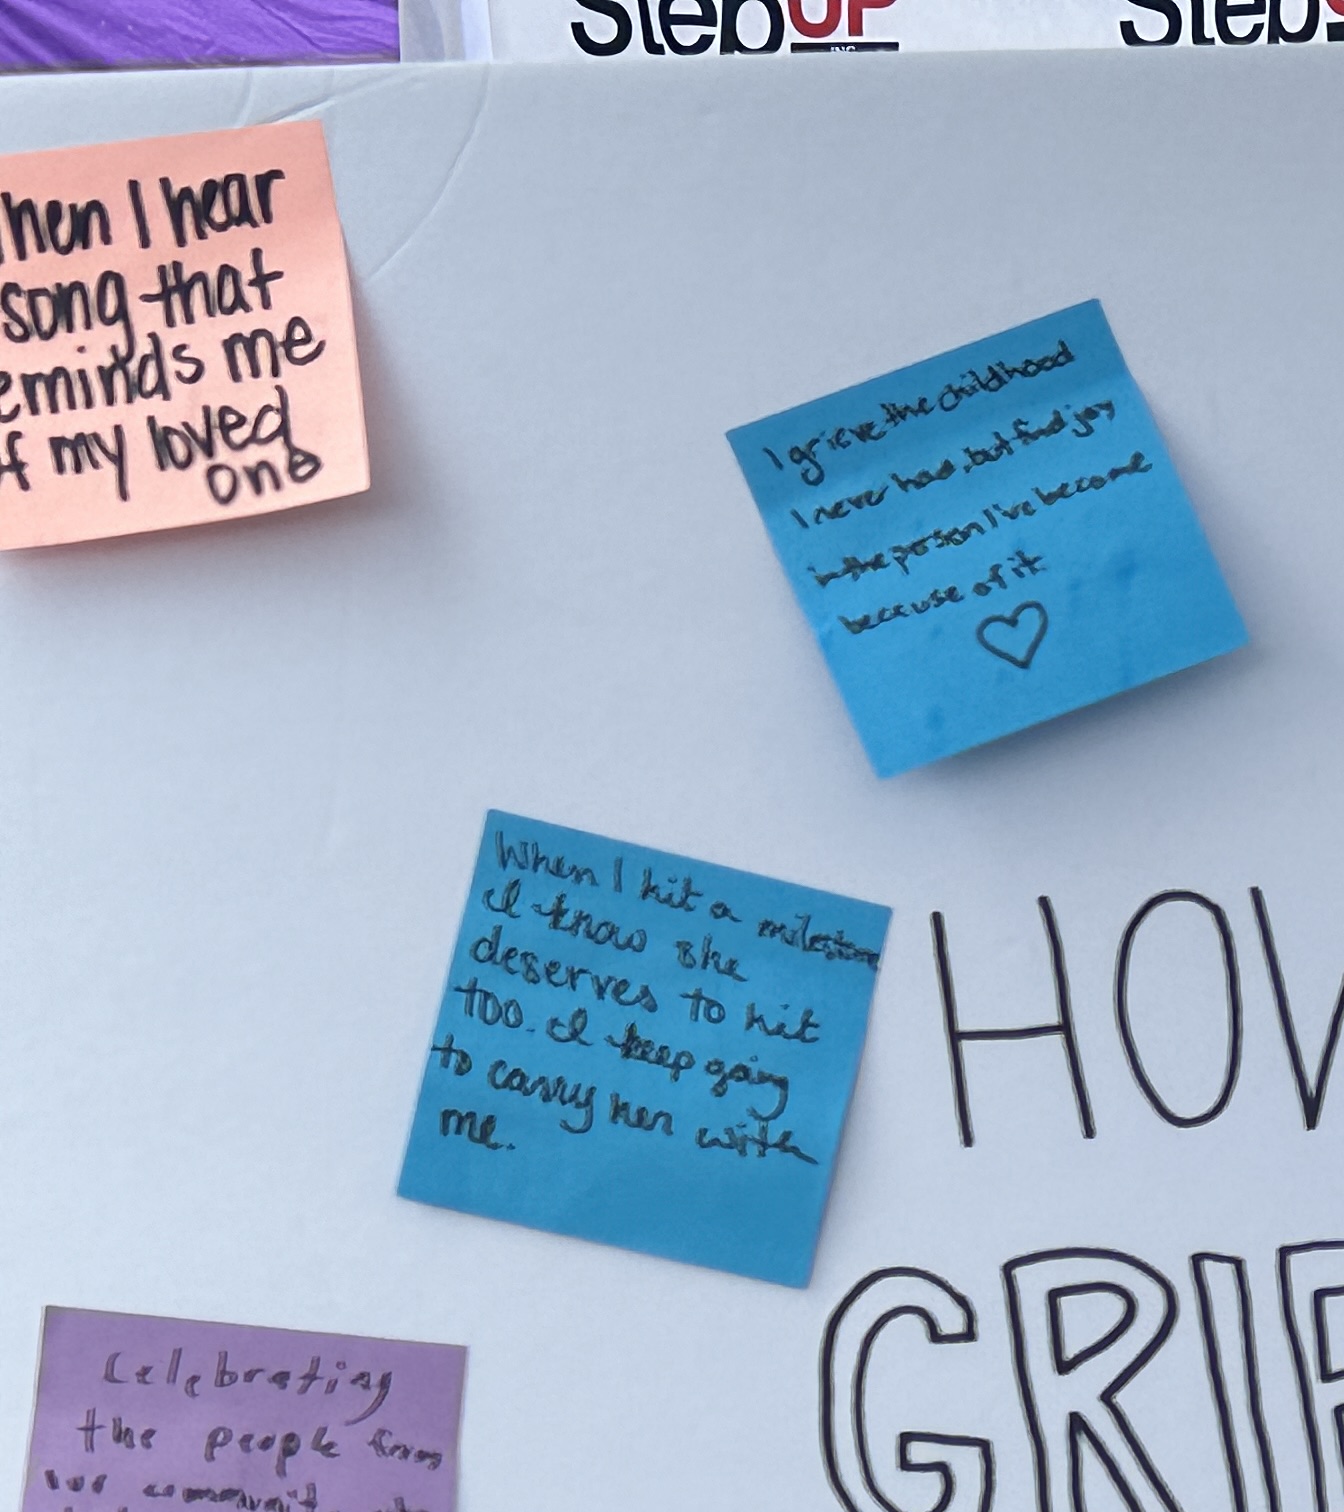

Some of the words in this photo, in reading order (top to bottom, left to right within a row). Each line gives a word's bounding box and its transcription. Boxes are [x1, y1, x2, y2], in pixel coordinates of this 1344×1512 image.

[128, 179, 150, 248] I
[160, 169, 285, 247] hear
[2, 271, 134, 362] song
[140, 247, 284, 327] that
[222, 317, 325, 382] me
[49, 423, 129, 501] my
[147, 385, 293, 471] loved
[763, 447, 785, 470] I
[787, 427, 888, 487] grieve
[937, 339, 1075, 412] childhood
[791, 508, 810, 528] I
[889, 520, 985, 575] person
[972, 565, 1007, 597] of
[1007, 550, 1048, 579] it
[495, 831, 599, 887] When
[613, 857, 622, 892] I
[641, 867, 703, 912] hit
[709, 900, 742, 922] a
[470, 925, 658, 1013] deserves
[680, 988, 726, 1024] to
[745, 1002, 820, 1043] hit
[675, 933, 748, 982] she
[431, 1033, 472, 1076] to
[609, 1091, 674, 1135] her
[705, 1055, 790, 1121] going
[103, 1347, 392, 1427] Celebrating
[76, 1407, 157, 1453] the
[205, 1426, 341, 1478] people
